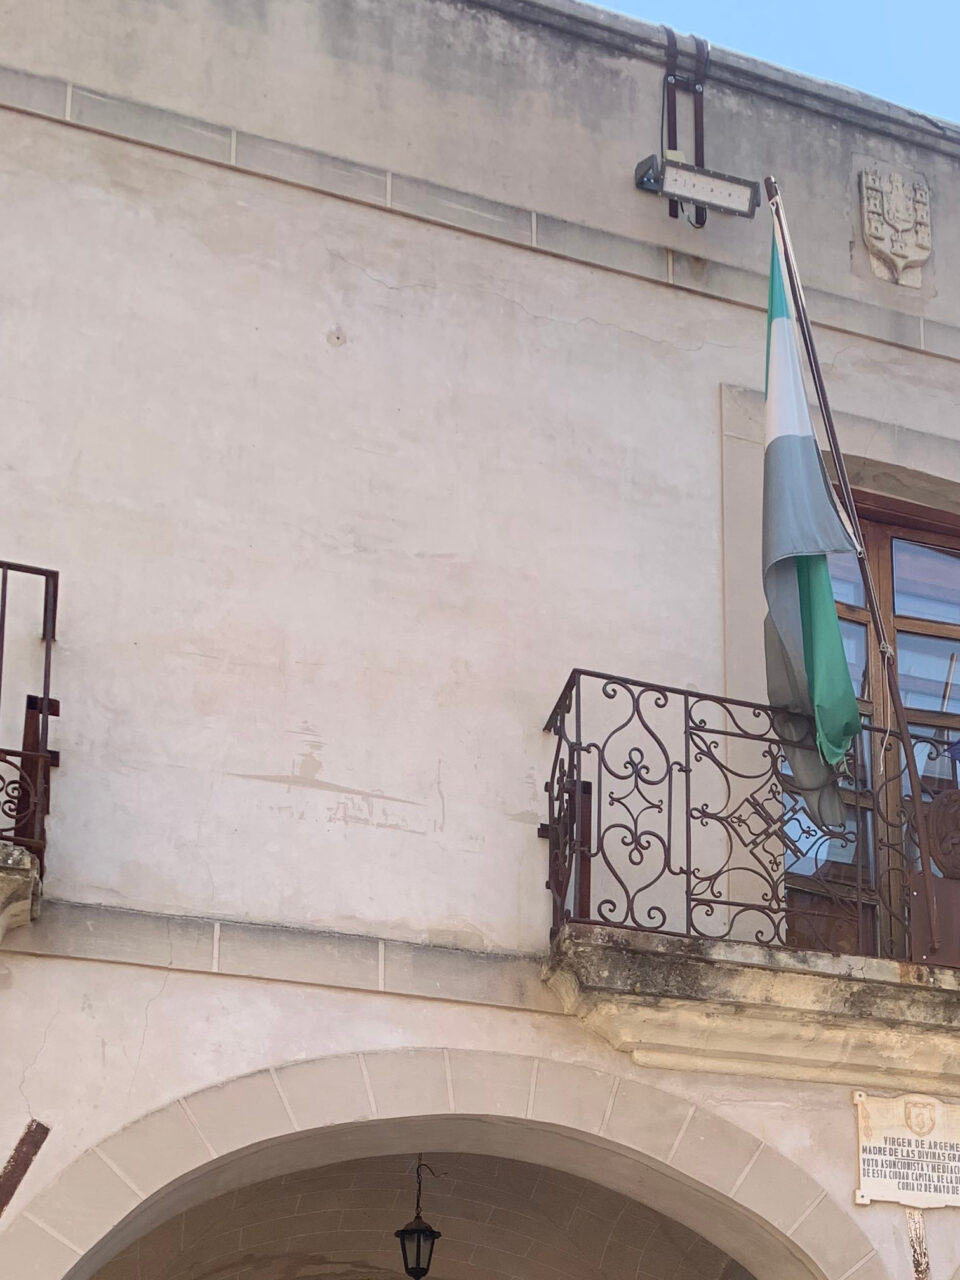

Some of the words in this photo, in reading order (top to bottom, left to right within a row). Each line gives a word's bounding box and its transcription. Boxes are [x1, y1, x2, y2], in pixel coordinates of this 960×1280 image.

[883, 1136, 912, 1148] VIRGEN
[915, 1139, 925, 1149] DE
[928, 1140, 960, 1152] ARGEME
[862, 1145, 887, 1156] MADRE
[889, 1147, 898, 1157] DE
[901, 1149, 915, 1158] LAS
[917, 1150, 946, 1161] DIVINAS
[862, 1158, 878, 1168] VOTO
[881, 1159, 924, 1172] ASUNCIONISTA
[926, 1163, 930, 1172] Y
[862, 1168, 870, 1178] DE
[872, 1169, 887, 1179] ESTA
[888, 1170, 909, 1181] CIUDAD
[911, 1172, 935, 1183] CAPITAL
[937, 1174, 945, 1184] DE
[946, 1175, 953, 1185] LA
[897, 1181, 915, 1191] CORIA
[916, 1183, 922, 1192] 12
[924, 1183, 932, 1193] DE
[933, 1184, 950, 1194] MAYO
[951, 1185, 959, 1195] DE
